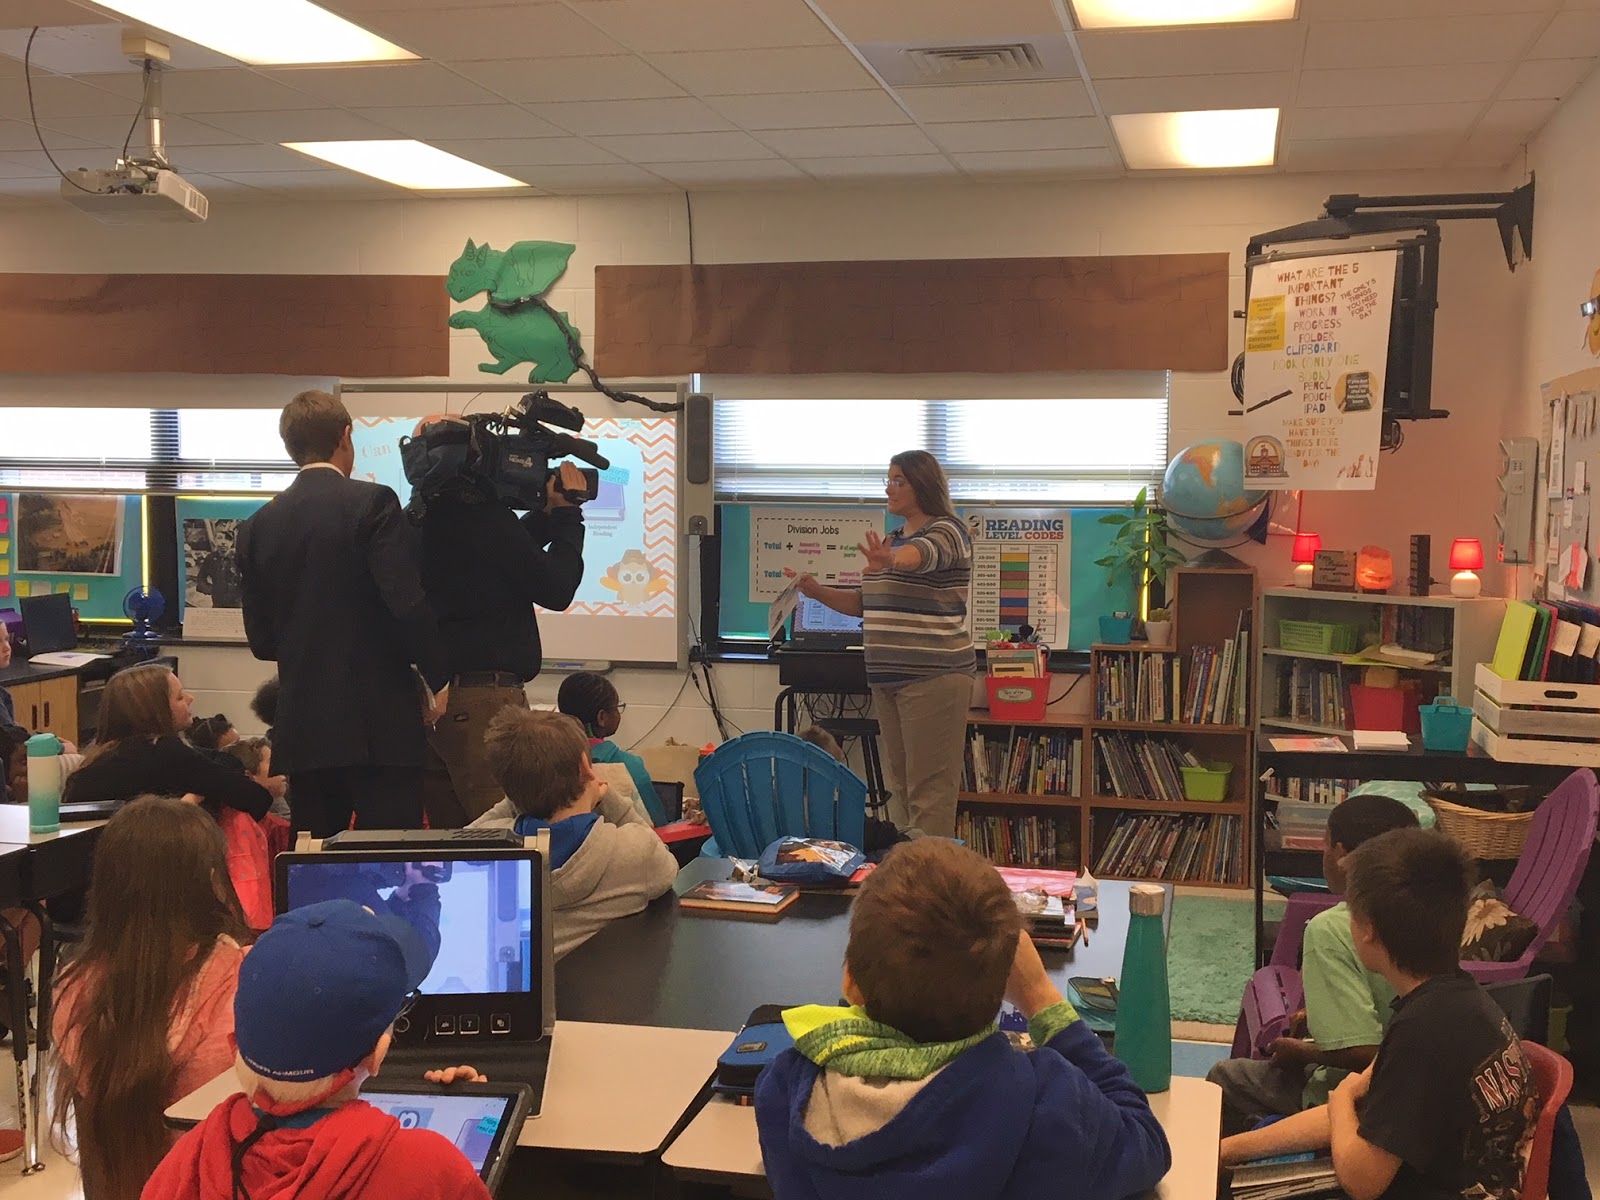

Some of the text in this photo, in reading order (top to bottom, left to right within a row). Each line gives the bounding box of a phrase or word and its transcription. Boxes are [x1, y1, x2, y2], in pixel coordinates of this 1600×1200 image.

[1278, 263, 1359, 283] WHAT ARE THE 5
[1288, 278, 1344, 294] IMPORTANT
[1340, 290, 1351, 300] THE
[1353, 280, 1370, 293] ONLY
[1295, 292, 1336, 306] THINGS?
[1346, 292, 1378, 311] YOU NEED
[1348, 288, 1372, 302] THINGS
[1300, 306, 1337, 318] WORK IN
[1351, 300, 1377, 317] FOR THE
[1359, 309, 1372, 320] DAY
[1294, 318, 1342, 332] PROGRESS
[1299, 332, 1334, 344] FOLDER
[1286, 342, 1340, 356] CLIPBOARD
[1273, 358, 1298, 370] BOOK
[1337, 354, 1359, 366] ONE
[1304, 381, 1332, 390] PENCIL
[1303, 393, 1331, 402] POUCH
[1282, 418, 1303, 426] MAKE
[1306, 418, 1326, 426] SURE
[1289, 428, 1336, 437] HAVE THESE
[1286, 438, 1313, 447] THINGS
[1316, 438, 1327, 446] TO
[362, 444, 392, 458] Can
[1326, 448, 1340, 456] THE
[788, 524, 839, 535] Division Jobs
[985, 520, 1064, 531] READING
